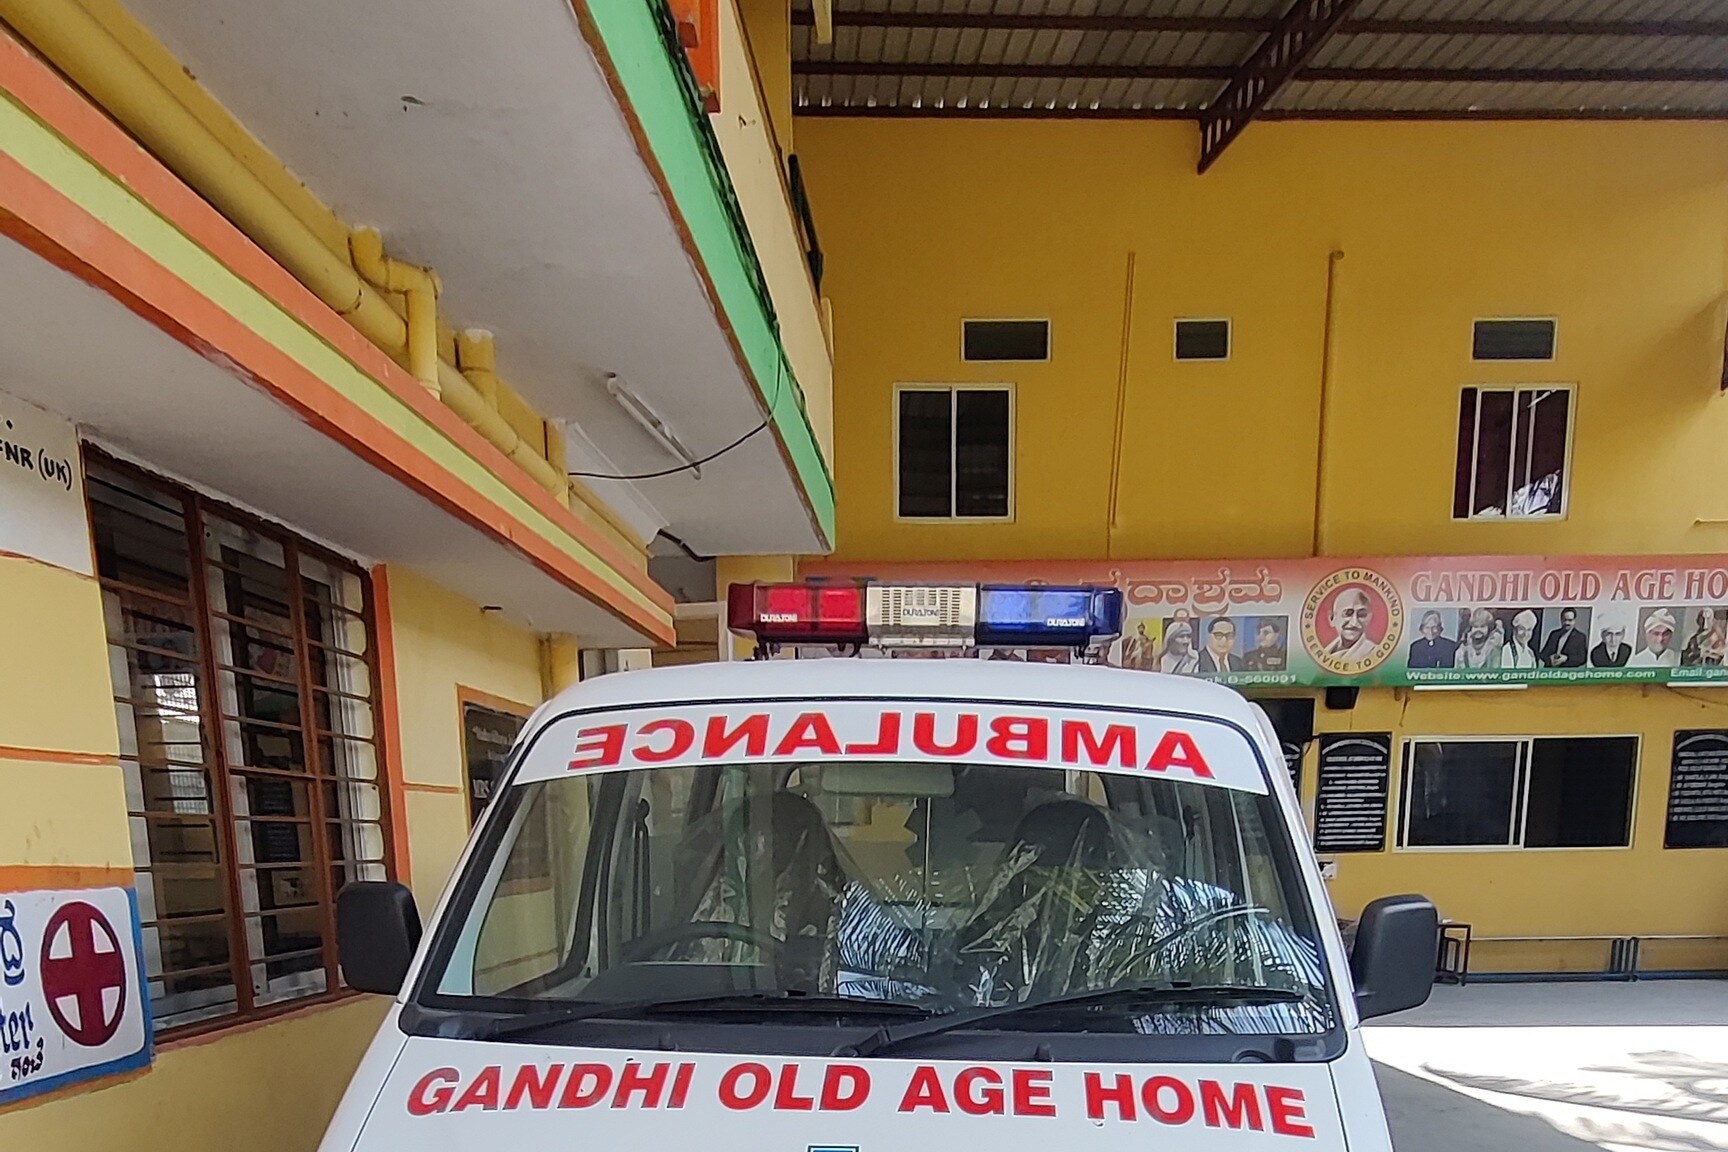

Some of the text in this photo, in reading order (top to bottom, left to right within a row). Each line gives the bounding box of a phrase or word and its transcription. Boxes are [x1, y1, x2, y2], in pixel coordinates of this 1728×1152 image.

[38, 448, 73, 491] (UK)
[1305, 570, 1400, 619] SERVICE TO MANKIND
[1410, 571, 1533, 603] GANDHI
[1539, 571, 1601, 602] OLD
[1610, 570, 1676, 602] AGE
[1306, 633, 1396, 671] SERVICE TO GOD
[406, 1062, 1316, 1139] GANDHI OLD AGE HOME
